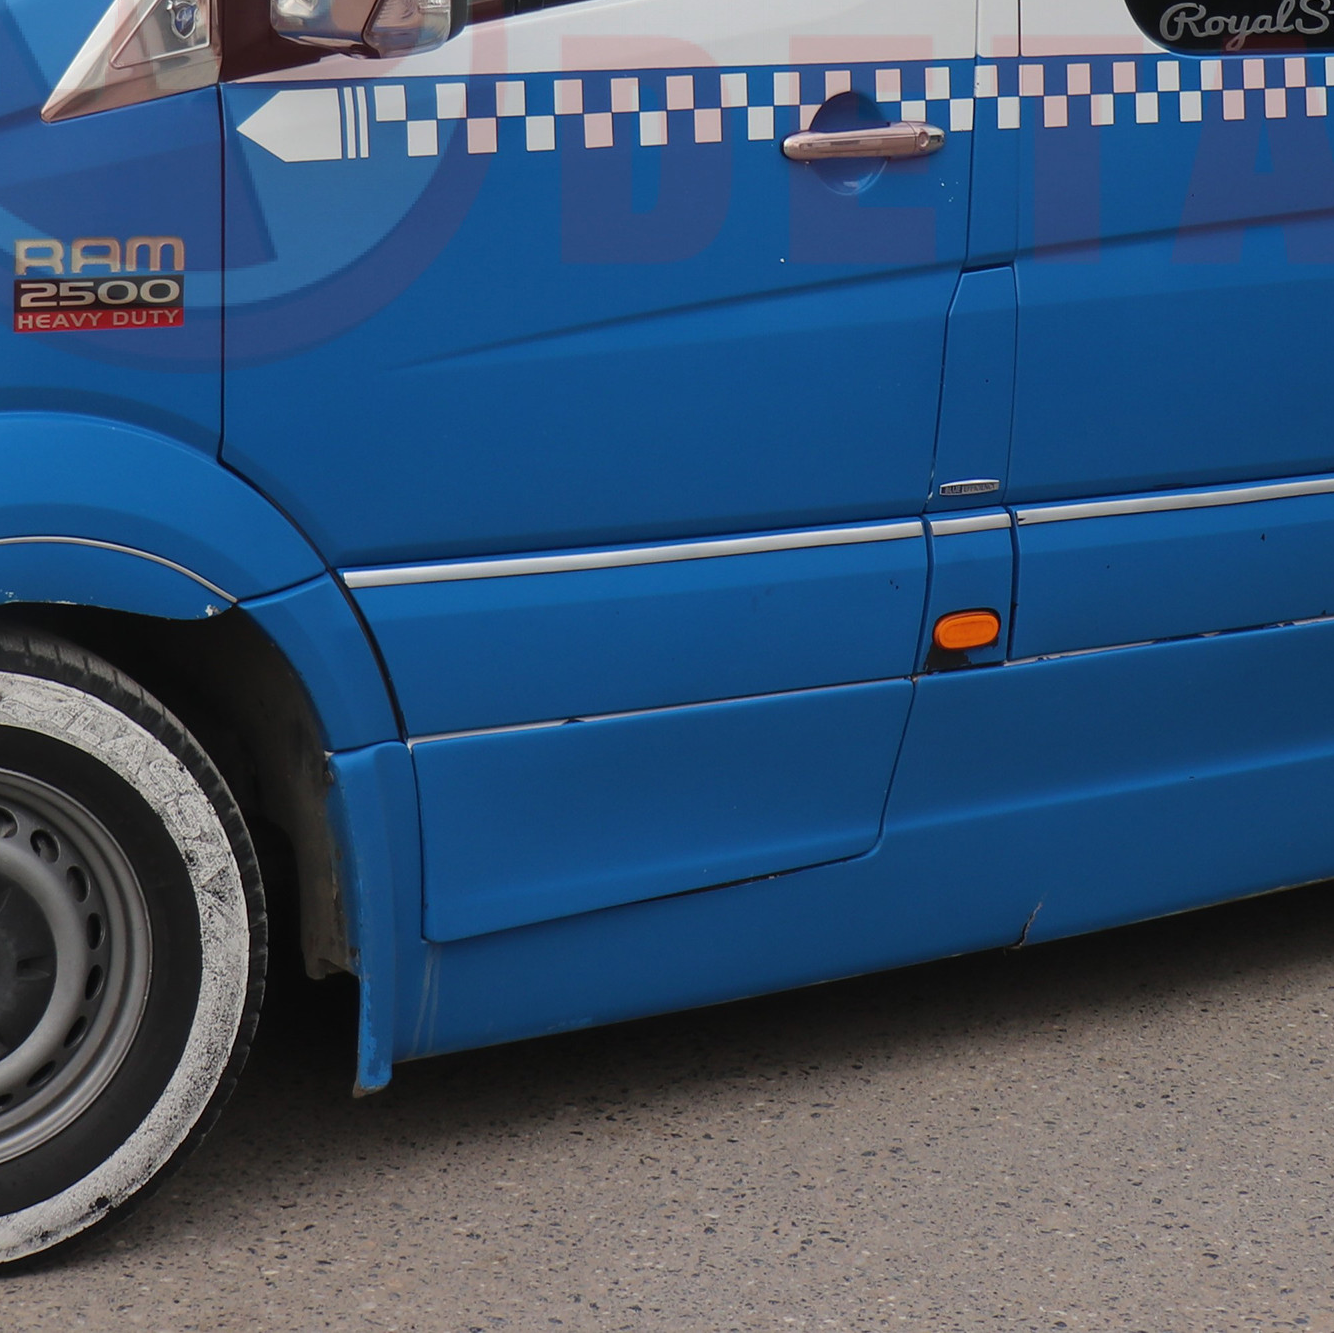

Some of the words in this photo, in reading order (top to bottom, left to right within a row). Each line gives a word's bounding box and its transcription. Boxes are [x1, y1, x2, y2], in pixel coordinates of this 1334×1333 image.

[14, 235, 185, 276] RAM
[20, 278, 181, 308] 2500
[18, 312, 103, 330] HEAVY
[113, 309, 180, 326] DUTY
